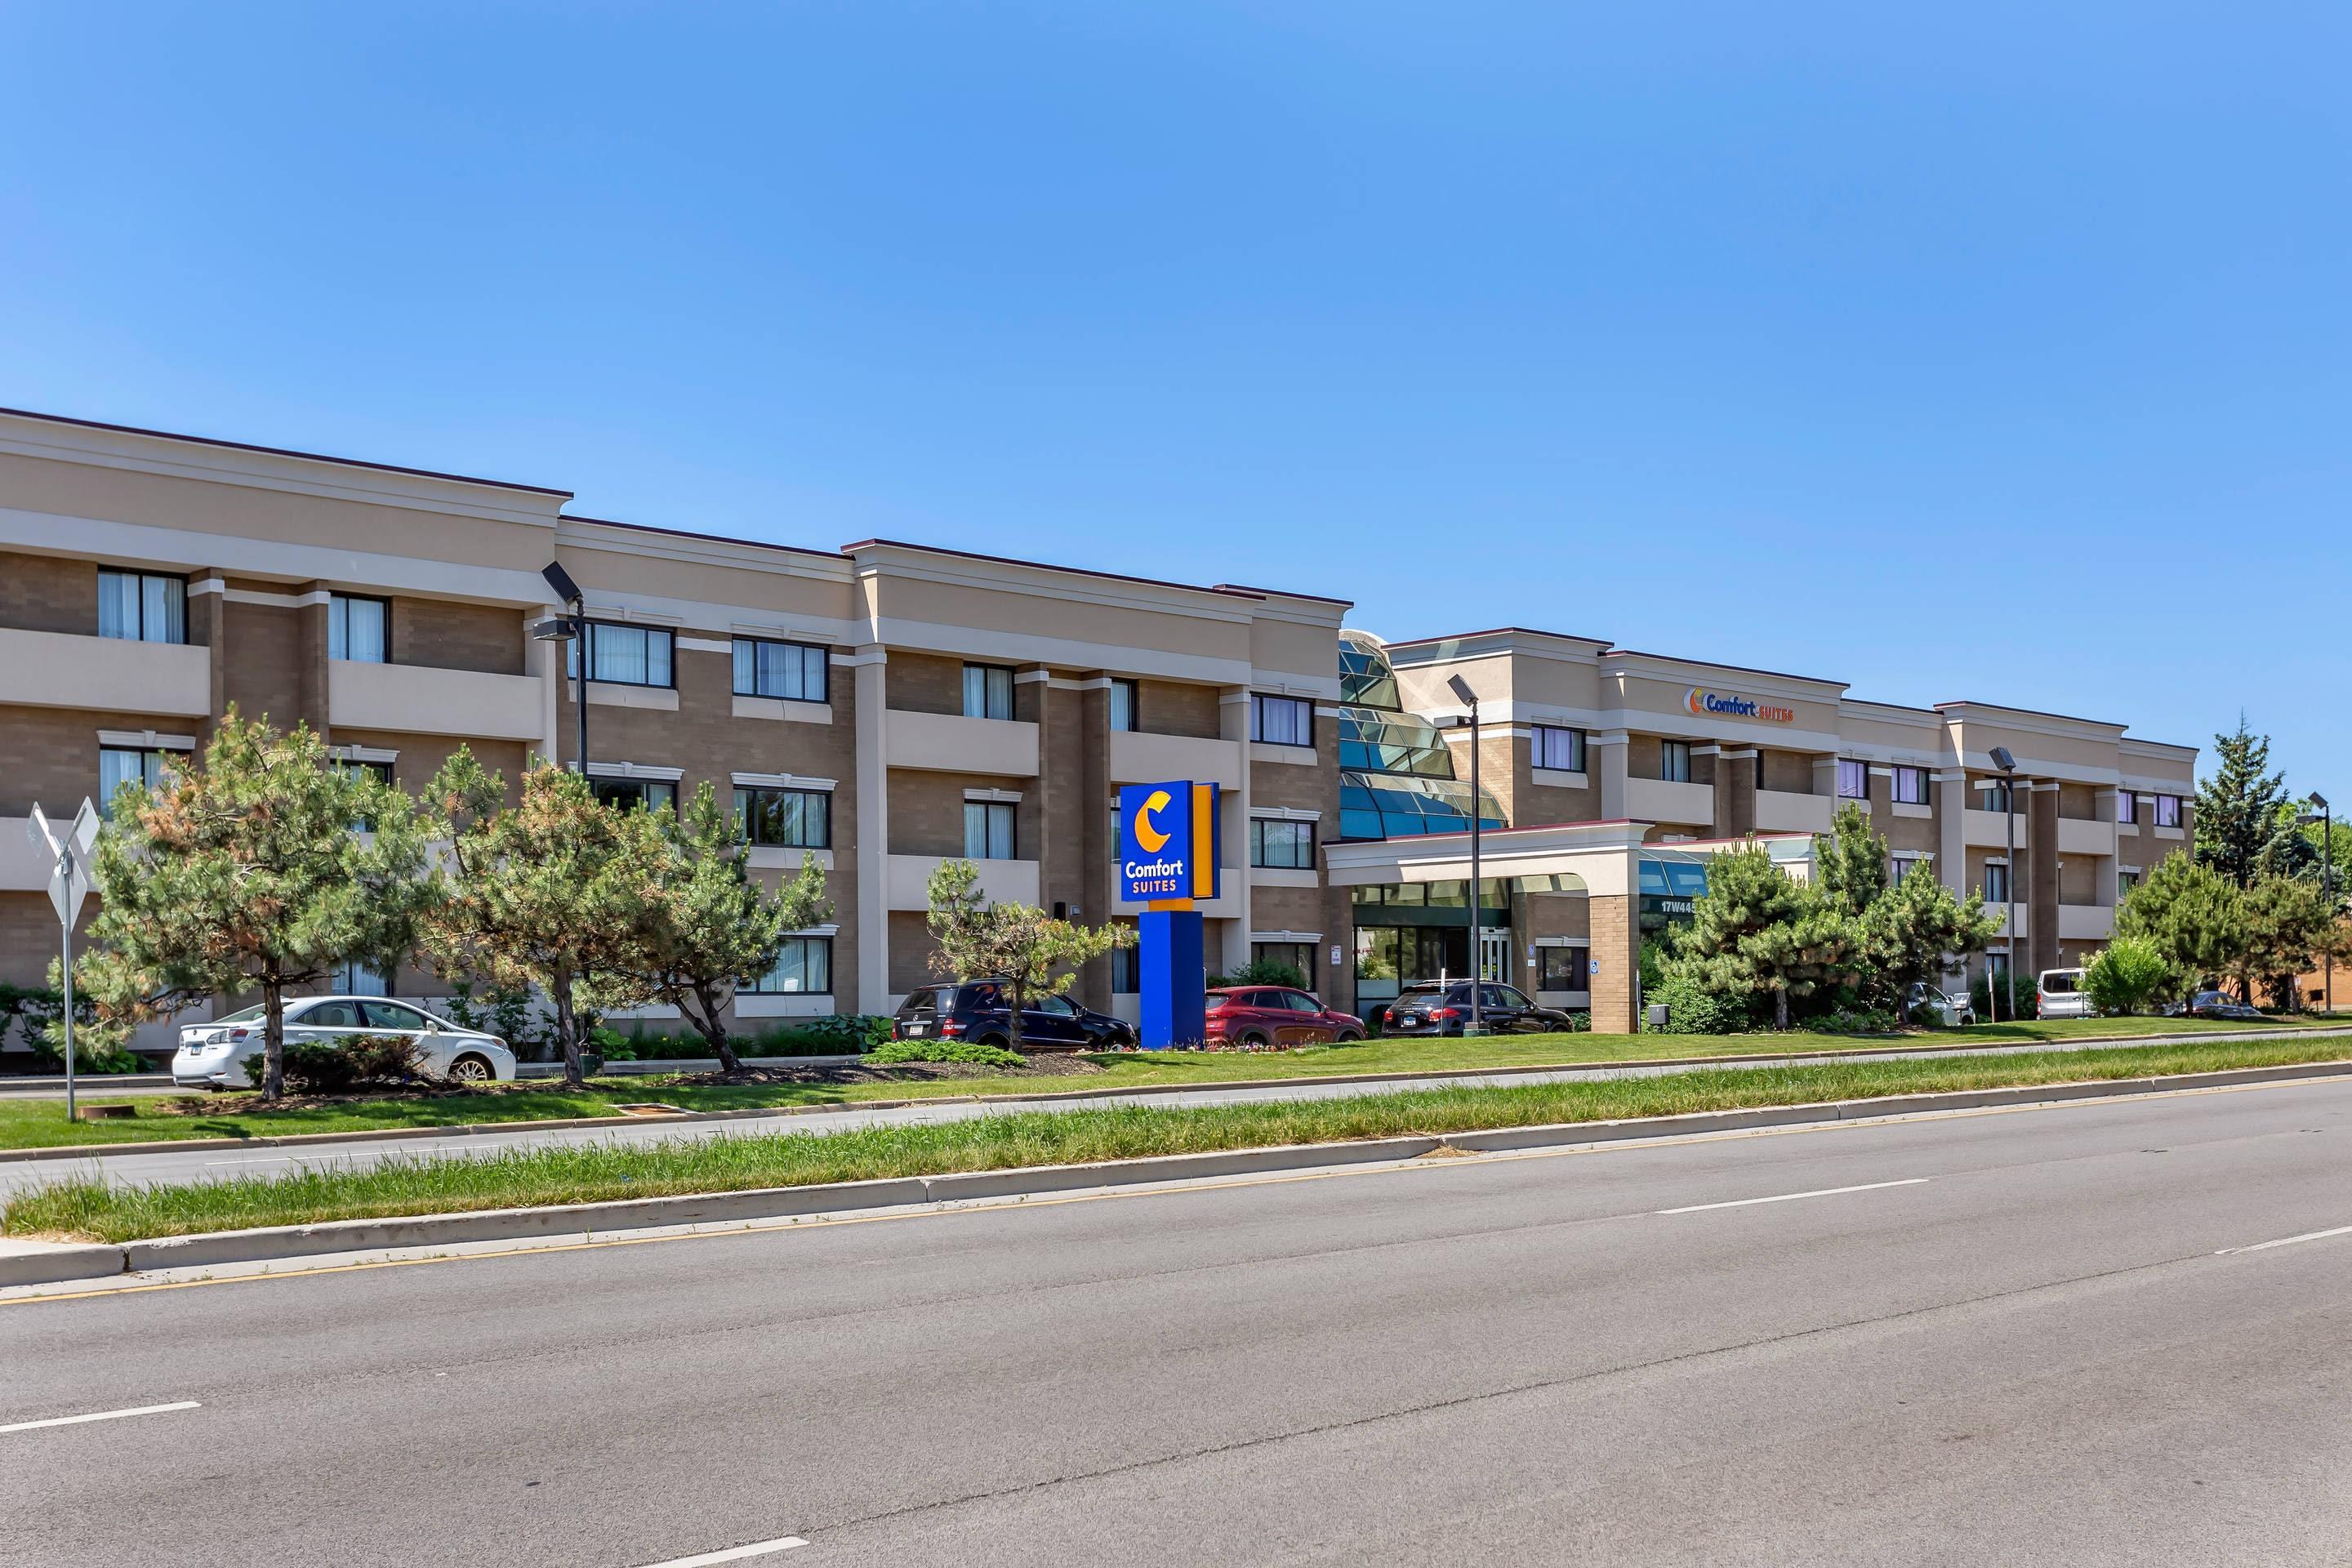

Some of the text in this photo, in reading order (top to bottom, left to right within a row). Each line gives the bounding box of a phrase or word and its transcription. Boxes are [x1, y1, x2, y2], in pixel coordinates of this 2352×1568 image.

[1704, 693, 1794, 721] Comfort SUITES
[1125, 858, 1183, 879] Comfort
[1133, 879, 1176, 894] SUITES
